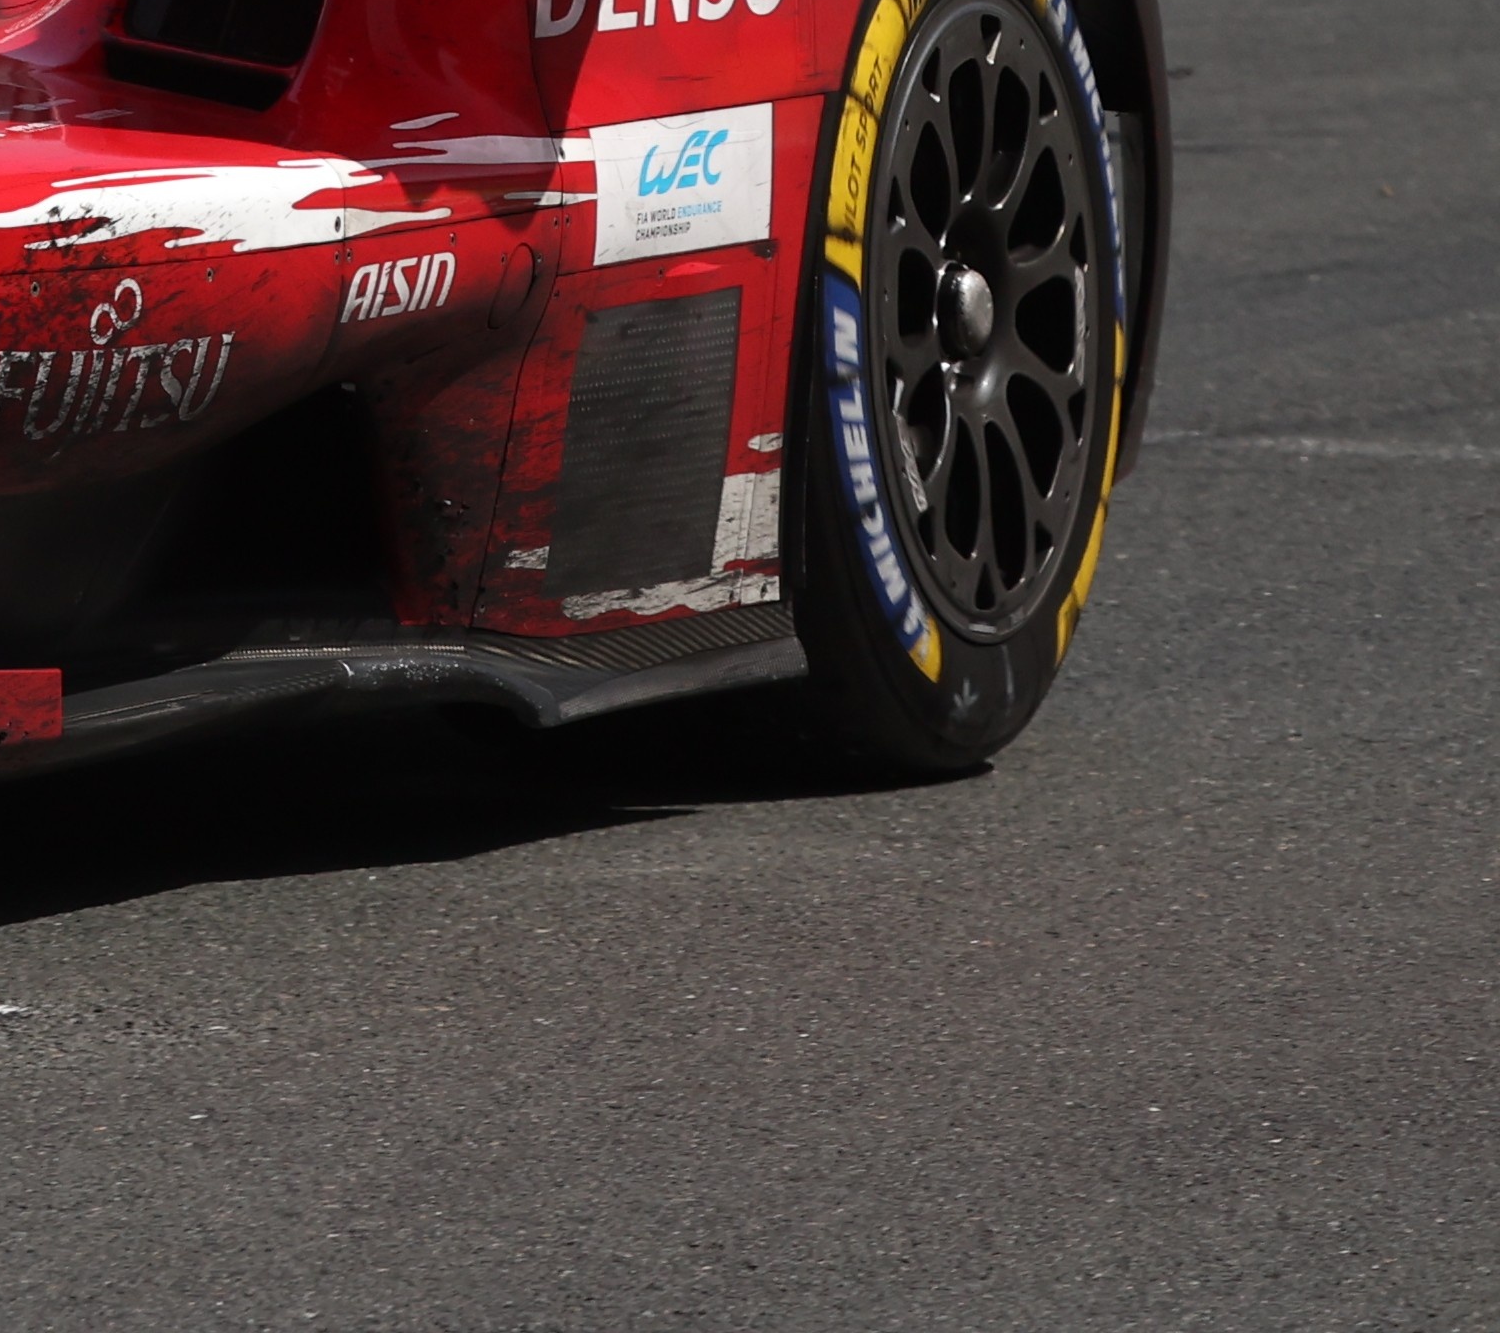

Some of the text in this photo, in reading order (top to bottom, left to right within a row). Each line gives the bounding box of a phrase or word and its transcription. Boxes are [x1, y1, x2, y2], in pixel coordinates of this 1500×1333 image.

[855, 58, 885, 147] SPORT
[637, 128, 729, 197] WEC
[635, 221, 691, 242] CHAMPIONSHIP
[636, 211, 649, 226] FIA
[650, 206, 676, 223] WORLD
[340, 251, 456, 325] AISIN
[833, 307, 899, 606] MICHELIN
